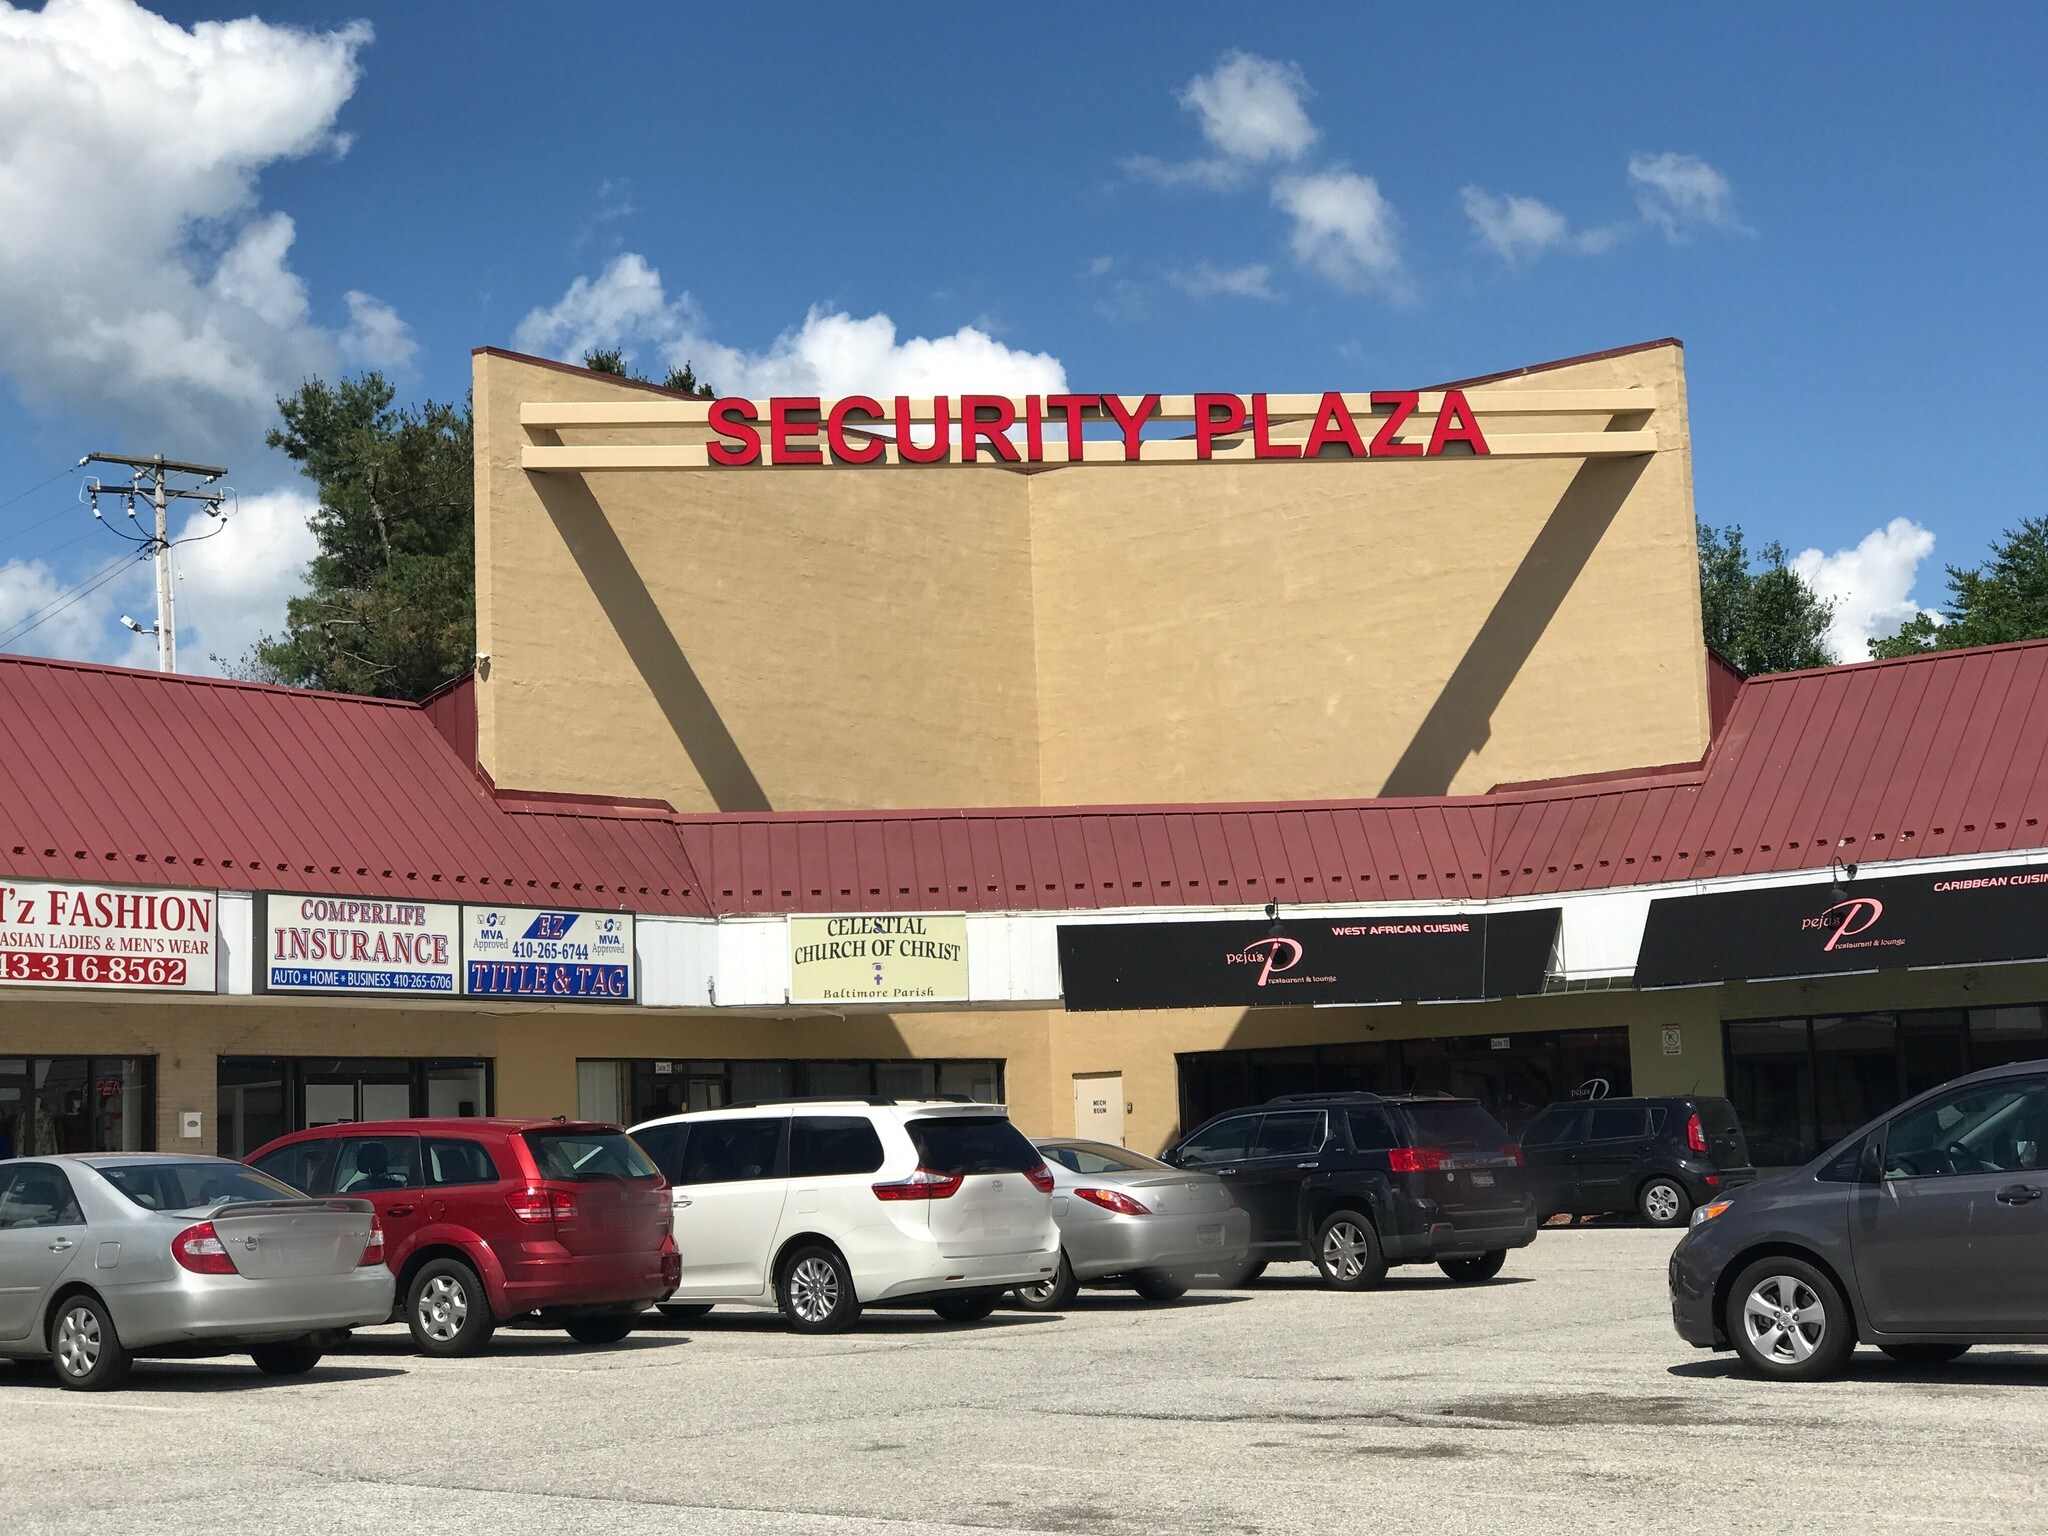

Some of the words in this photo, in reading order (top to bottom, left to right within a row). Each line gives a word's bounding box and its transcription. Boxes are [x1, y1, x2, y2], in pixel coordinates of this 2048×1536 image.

[706, 393, 1160, 466] SECURITY
[1193, 390, 1490, 460] PLAZA
[1933, 876, 2008, 893] CARIBBEAN
[47, 890, 212, 933] FASHION
[301, 899, 426, 926] COMPERLIFE
[481, 930, 503, 939] MVA
[537, 914, 565, 938] EZ
[827, 916, 927, 936] CELESTIAL
[1331, 926, 1367, 936] WEST
[1369, 925, 1421, 935] AFRICAN
[1423, 923, 1470, 933] CUISINE
[0, 932, 45, 948] ASIAN
[49, 934, 101, 951] LADIES
[105, 939, 116, 951] &
[119, 937, 165, 952] MEN'S
[168, 940, 209, 955] WEAR
[274, 927, 449, 966] INSURANCE
[473, 938, 509, 951] Approved
[592, 943, 625, 955] Approved
[599, 935, 620, 944] MVA
[1834, 940, 1873, 949] restaurant
[1880, 938, 1906, 946] lounge
[512, 941, 589, 960] 410-265-6744
[794, 939, 867, 965] CHURCH
[871, 939, 895, 956] OF
[899, 939, 961, 961] CHRIST
[273, 969, 301, 984] AUTO
[309, 971, 339, 986] HOME
[347, 972, 391, 987] BUSINESS
[393, 975, 452, 989] 410-265-6706
[471, 962, 549, 992] TITLE
[552, 965, 571, 994] &
[576, 966, 625, 996] TAG
[1268, 976, 1305, 984] restaurant
[1312, 975, 1337, 983] lounge
[823, 988, 888, 998] Baltimore
[893, 986, 935, 997] Parish
